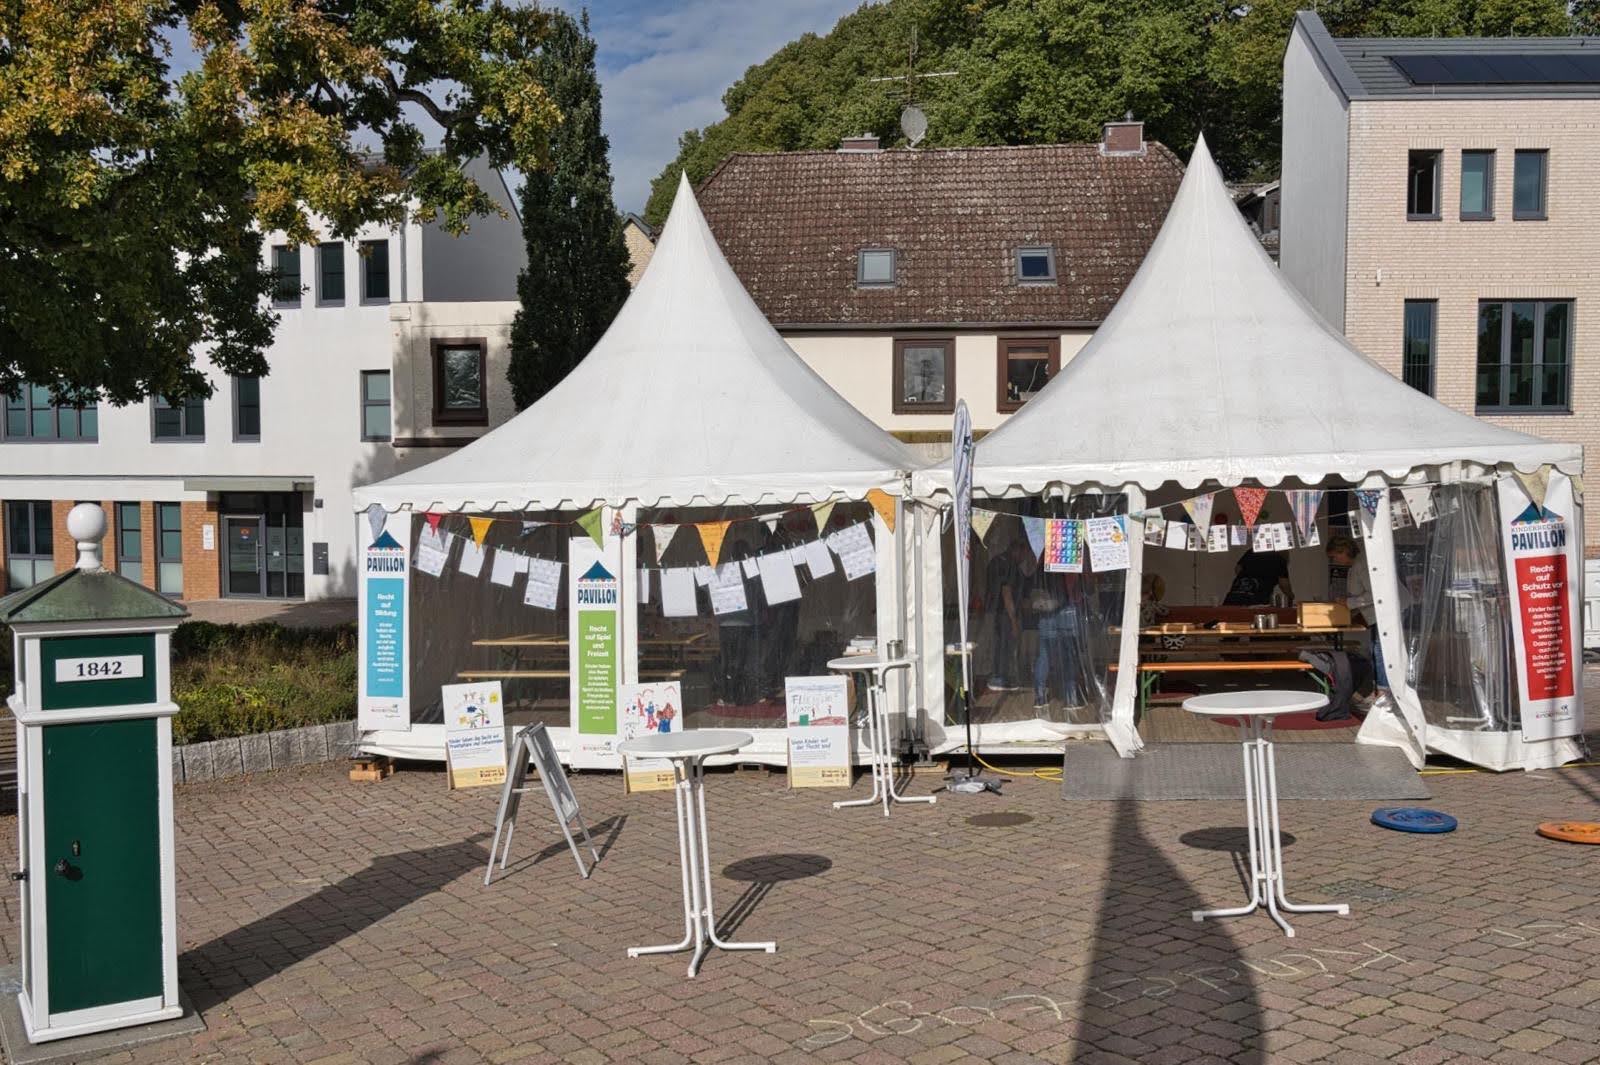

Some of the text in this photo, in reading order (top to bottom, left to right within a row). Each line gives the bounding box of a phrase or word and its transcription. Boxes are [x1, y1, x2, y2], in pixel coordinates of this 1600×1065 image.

[1511, 529, 1566, 551] PAVILLON
[367, 557, 405, 571] PAVILLON
[1529, 565, 1554, 573] Recht
[1535, 573, 1551, 581] auf
[1522, 583, 1551, 591] Schutz
[577, 589, 617, 604] PAVILLON
[1530, 591, 1558, 599] Gewalt
[596, 633, 612, 641] Spiel
[77, 661, 123, 677] 1842
